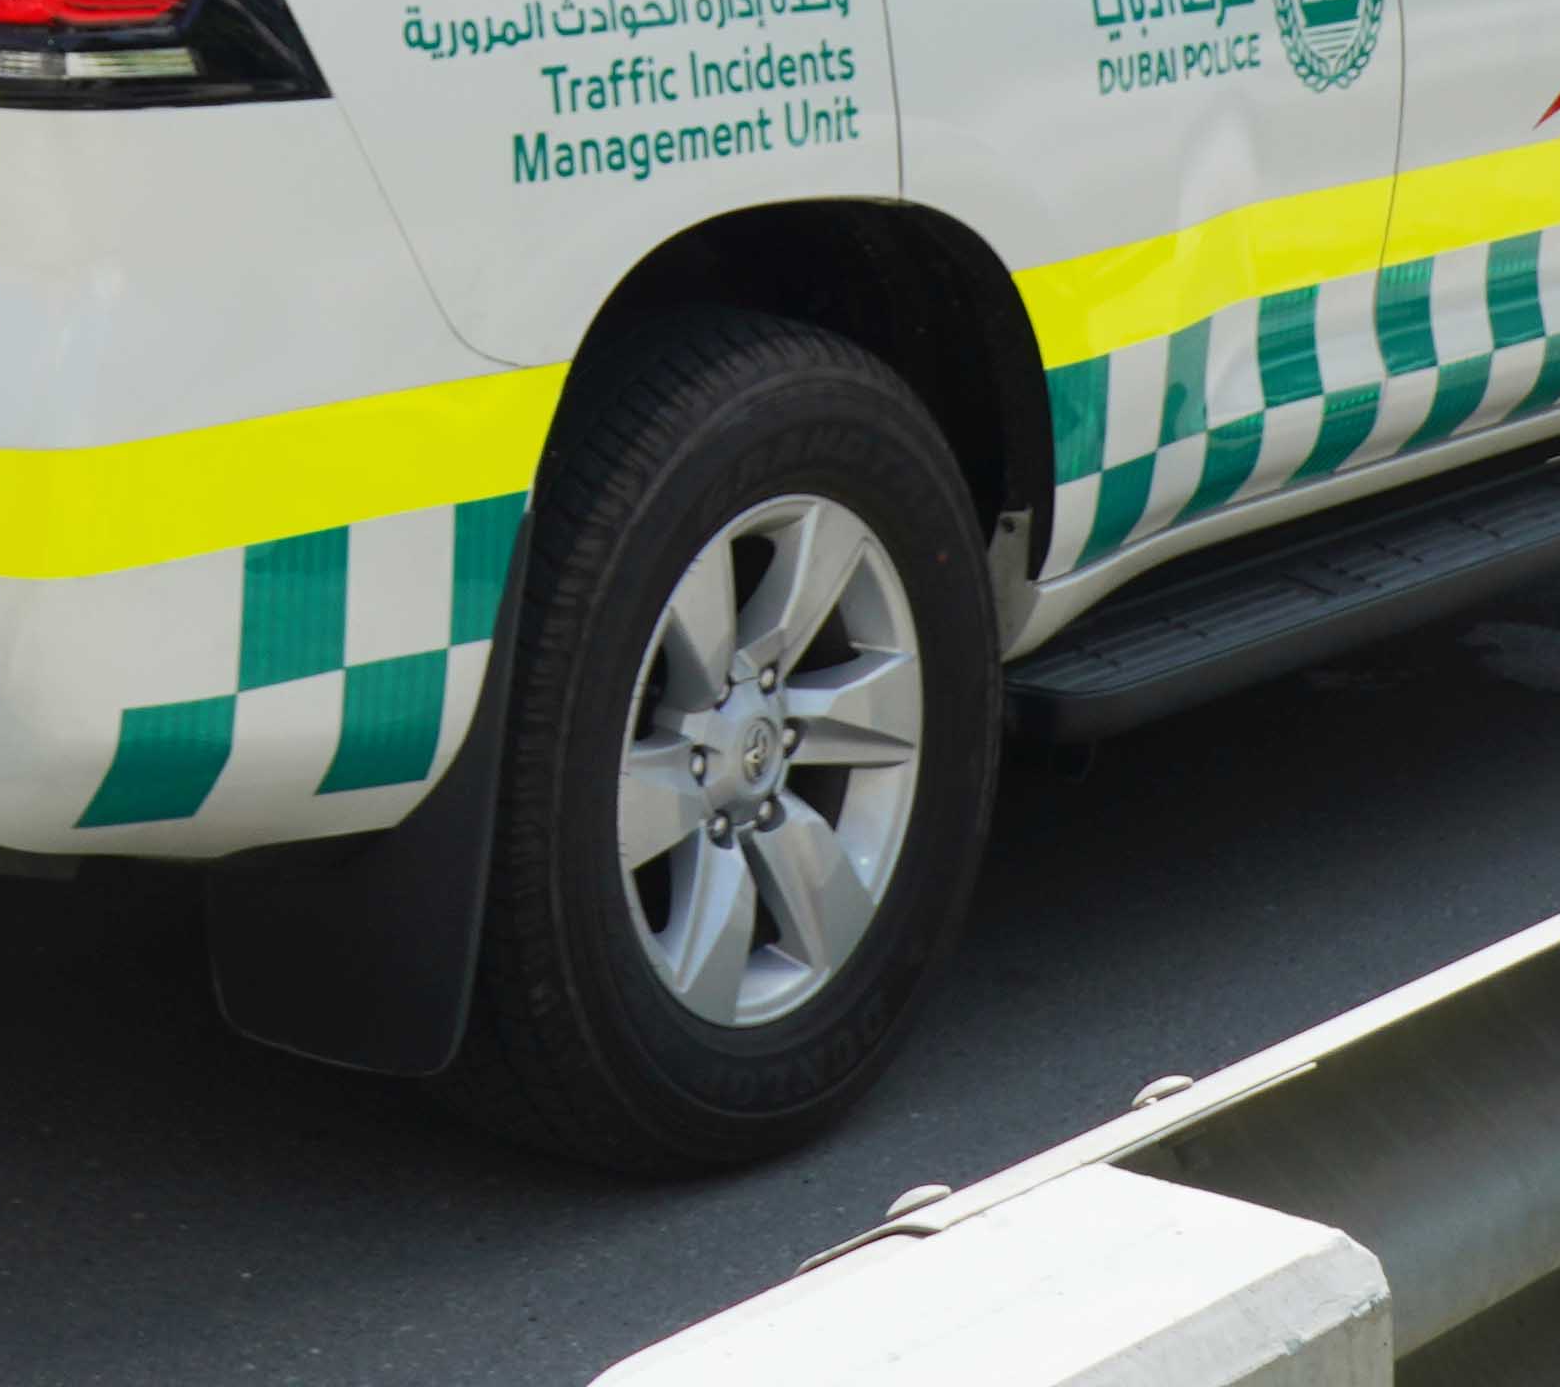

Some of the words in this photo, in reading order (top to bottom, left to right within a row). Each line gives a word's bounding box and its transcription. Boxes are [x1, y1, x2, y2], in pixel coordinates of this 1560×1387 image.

[403, 0, 544, 60] المرورية
[1097, 48, 1178, 96] DUBAI
[1182, 33, 1262, 81] POLICE
[541, 56, 678, 115] Traffic
[689, 38, 856, 98] Incidents
[513, 107, 773, 183] Management
[784, 95, 859, 147] Unit
